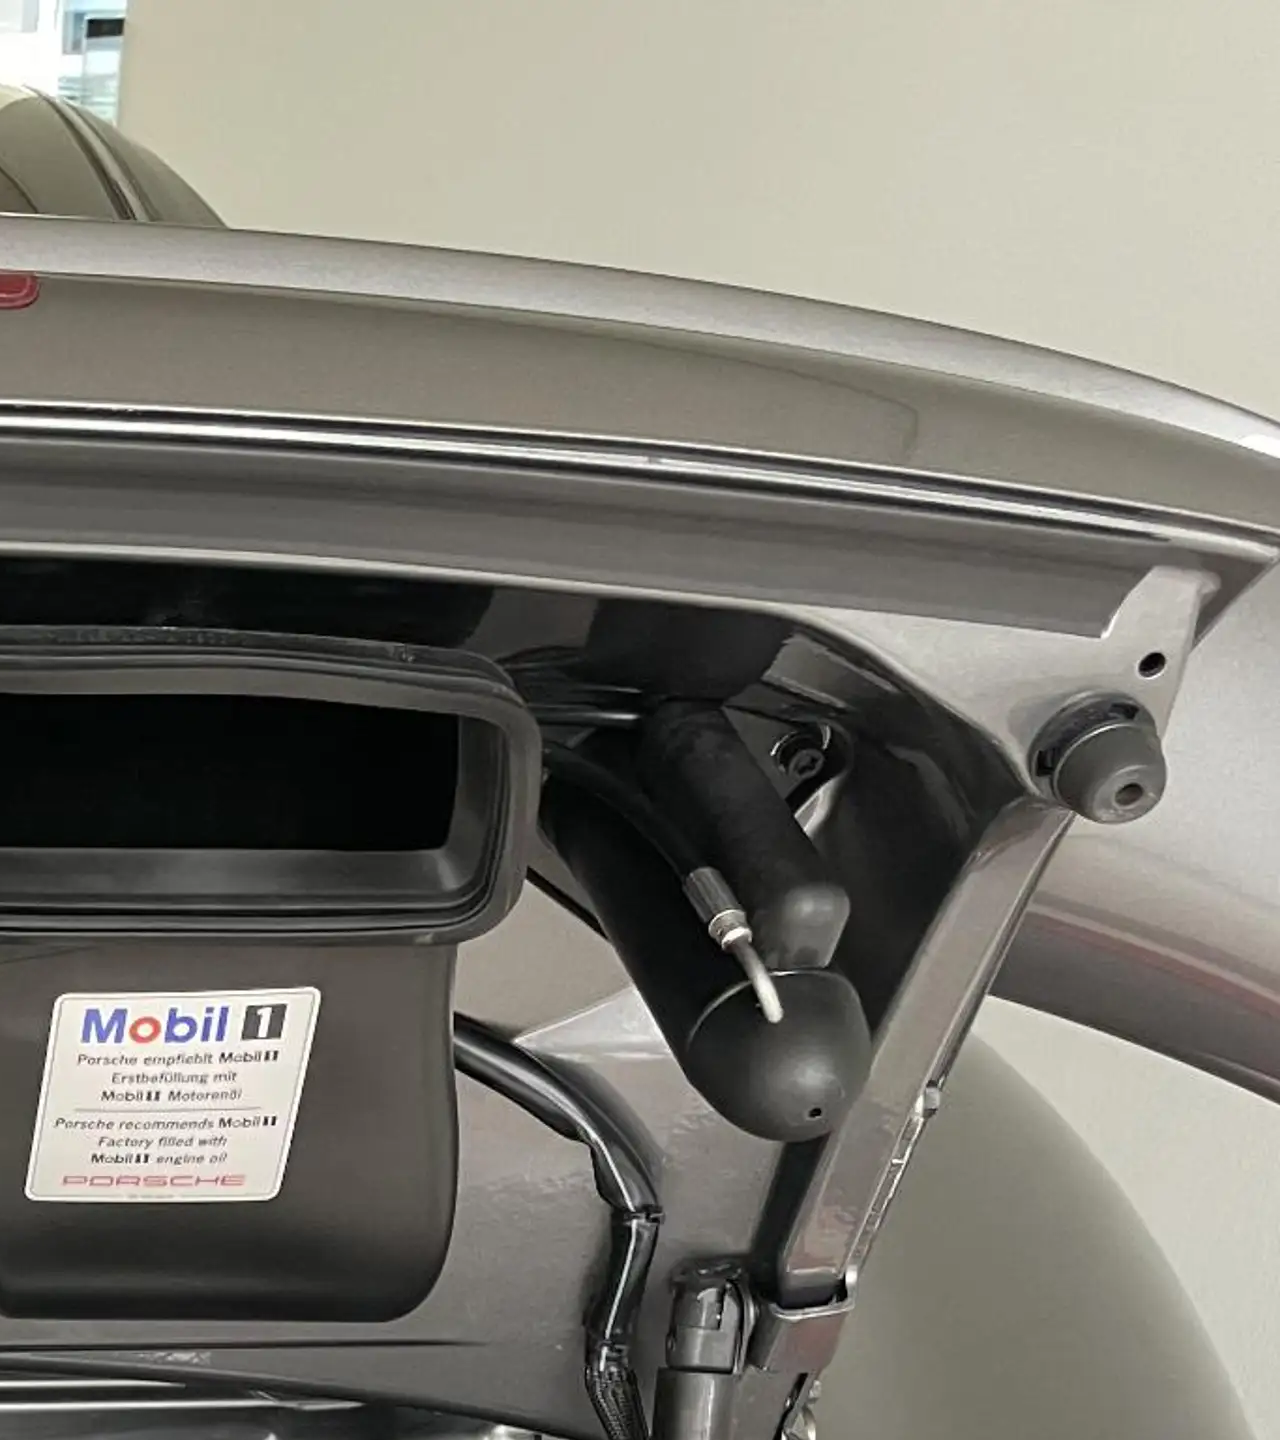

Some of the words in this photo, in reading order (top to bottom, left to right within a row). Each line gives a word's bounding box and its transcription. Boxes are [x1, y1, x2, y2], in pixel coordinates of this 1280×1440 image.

[80, 1006, 230, 1044] Mobil
[77, 1053, 138, 1066] Porsche
[143, 1052, 213, 1068] empfiehlt
[111, 1071, 208, 1085] Erstbefüllung
[213, 1071, 237, 1083] mit
[167, 1089, 243, 1102] Motorenöl
[54, 1117, 115, 1130] Porsche
[119, 1118, 214, 1130] recommends
[97, 1136, 153, 1149] Factory
[158, 1136, 194, 1148] filled
[198, 1136, 228, 1148] with
[156, 1154, 205, 1166] engine
[209, 1152, 228, 1164] oil
[61, 1175, 246, 1187] PORSCHE
